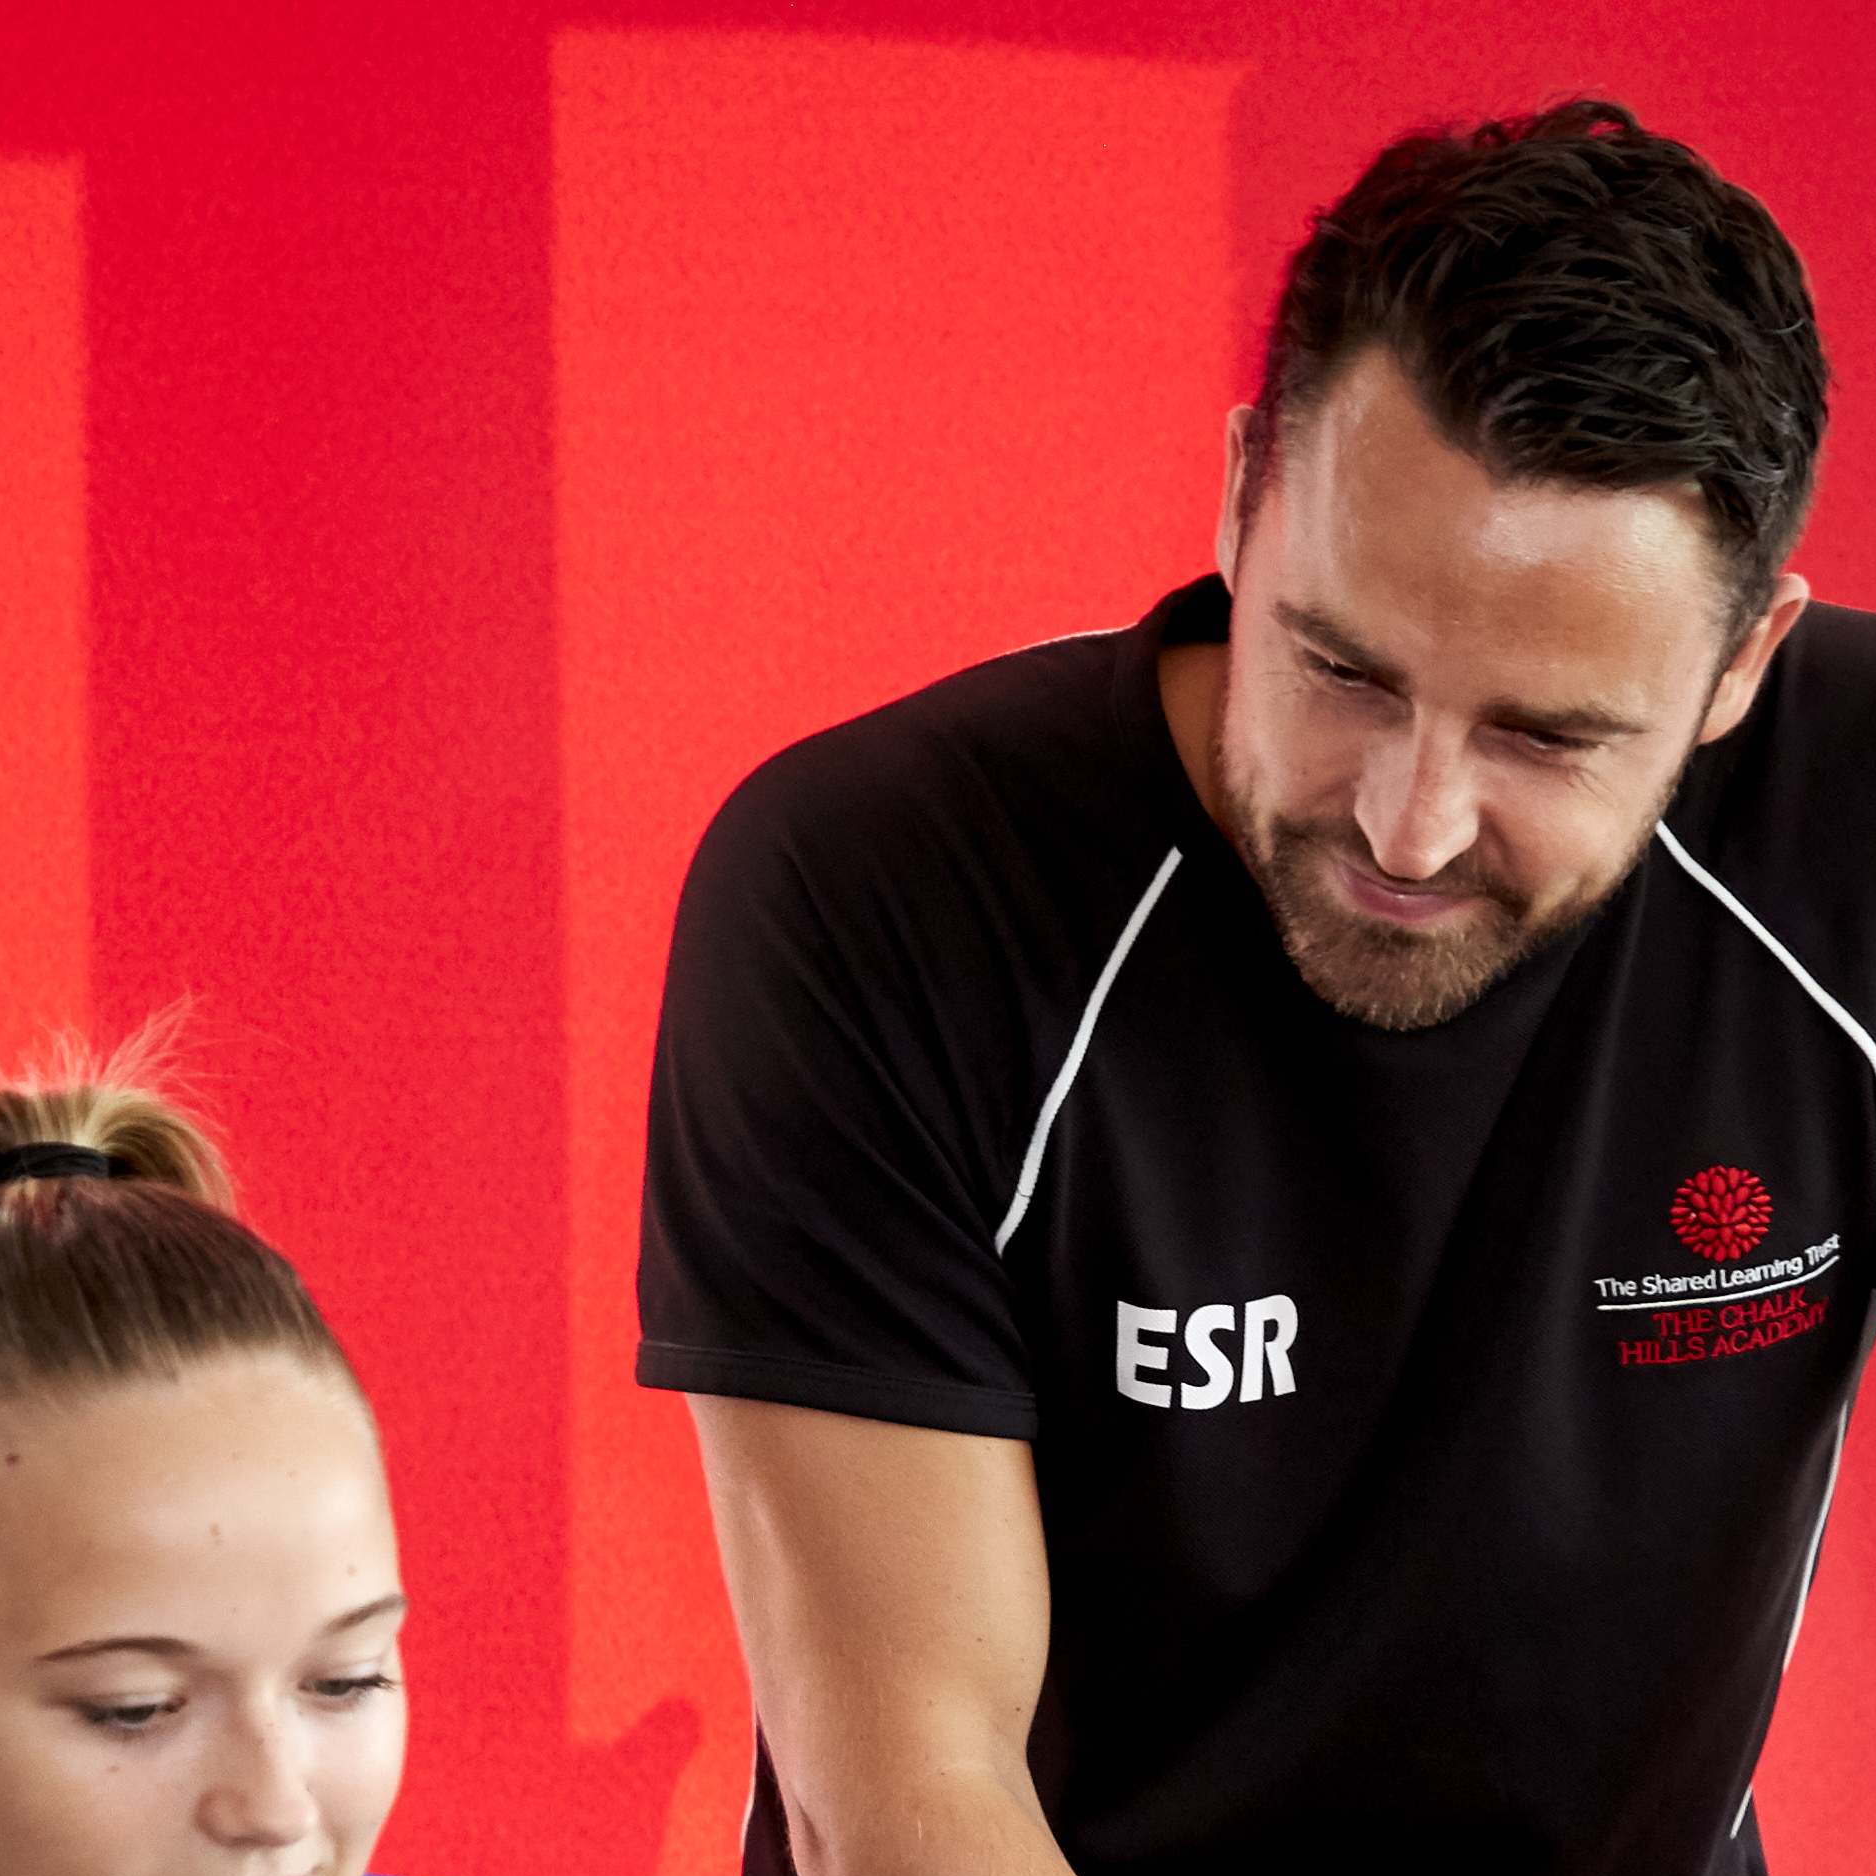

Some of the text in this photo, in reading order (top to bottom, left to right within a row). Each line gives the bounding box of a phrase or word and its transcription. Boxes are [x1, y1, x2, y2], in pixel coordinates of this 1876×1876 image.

[1594, 1233, 1841, 1297] The Shared Learning Trust
[1619, 1297, 1830, 1366] HILLS ACADEMY
[1652, 1286, 1810, 1337] THE CHALK
[1116, 1294, 1299, 1410] ESR
